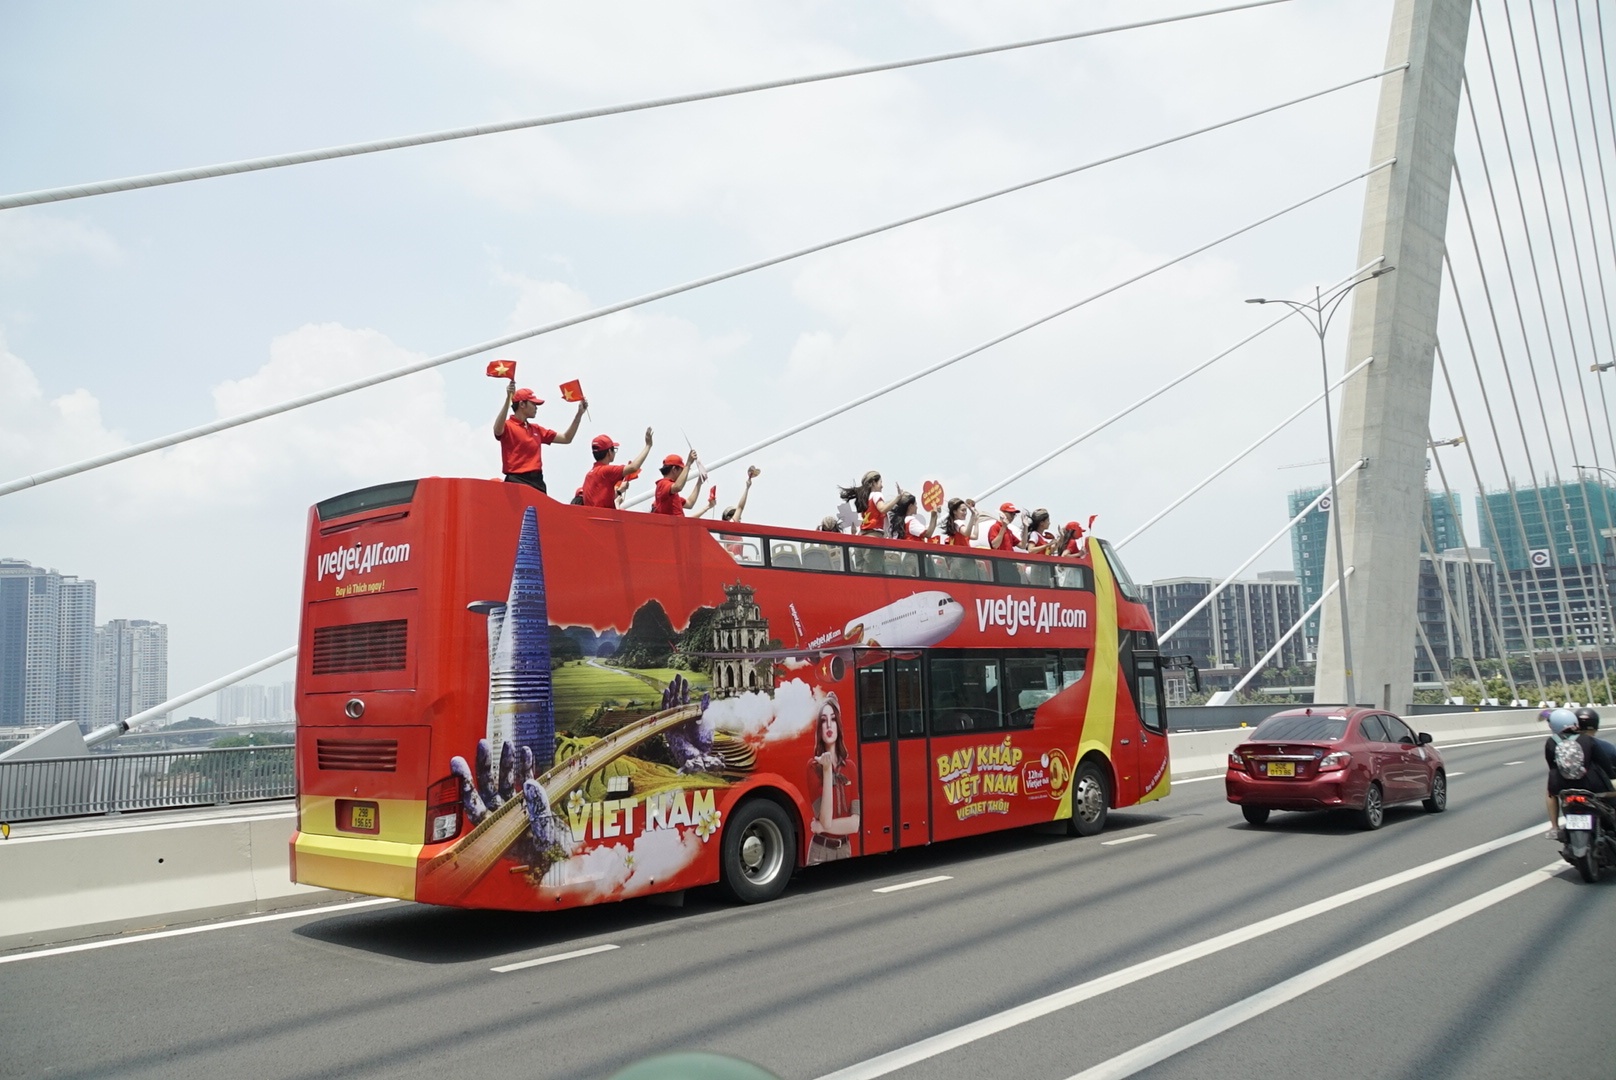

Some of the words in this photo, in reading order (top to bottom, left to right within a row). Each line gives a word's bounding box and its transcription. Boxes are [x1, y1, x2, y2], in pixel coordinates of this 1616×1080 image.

[937, 747, 975, 780] BAY
[943, 772, 981, 804] VIỆT
[983, 773, 1018, 796] NAM
[567, 798, 639, 842] VIET
[645, 788, 717, 833] NAM
